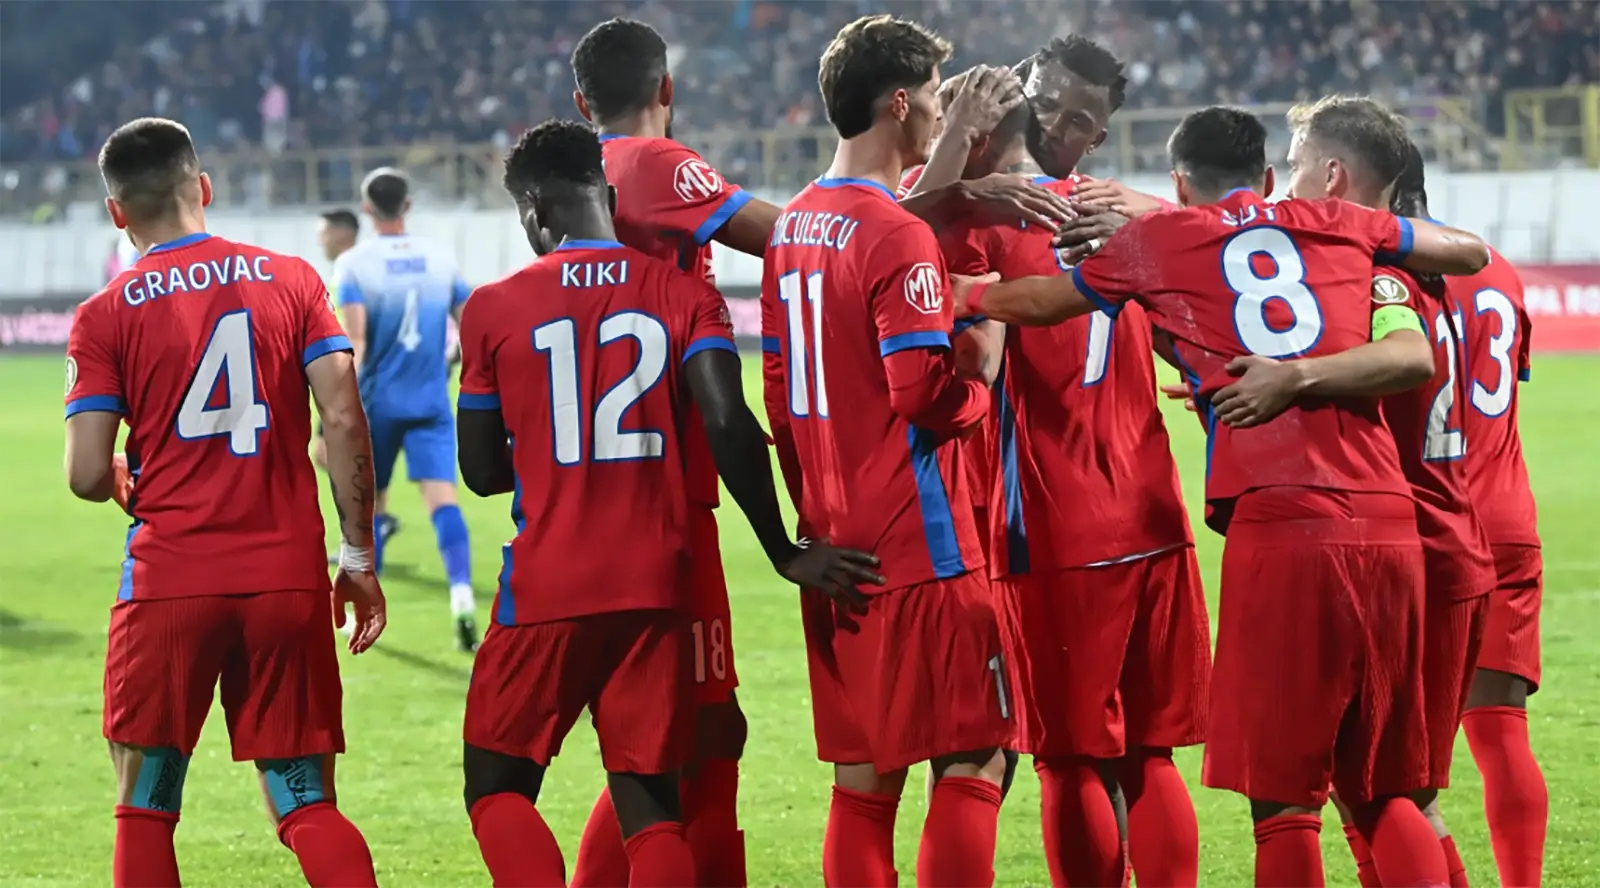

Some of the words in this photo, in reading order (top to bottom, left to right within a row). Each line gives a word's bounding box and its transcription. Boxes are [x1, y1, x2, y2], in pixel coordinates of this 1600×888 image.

[123, 254, 274, 306] GRAOVAC
[397, 288, 422, 352] 4
[560, 260, 629, 288] KIKI
[1221, 225, 1324, 359] 8
[175, 308, 270, 457] 4
[532, 309, 670, 466] 12
[779, 268, 829, 420] 11
[692, 617, 726, 683] 18
